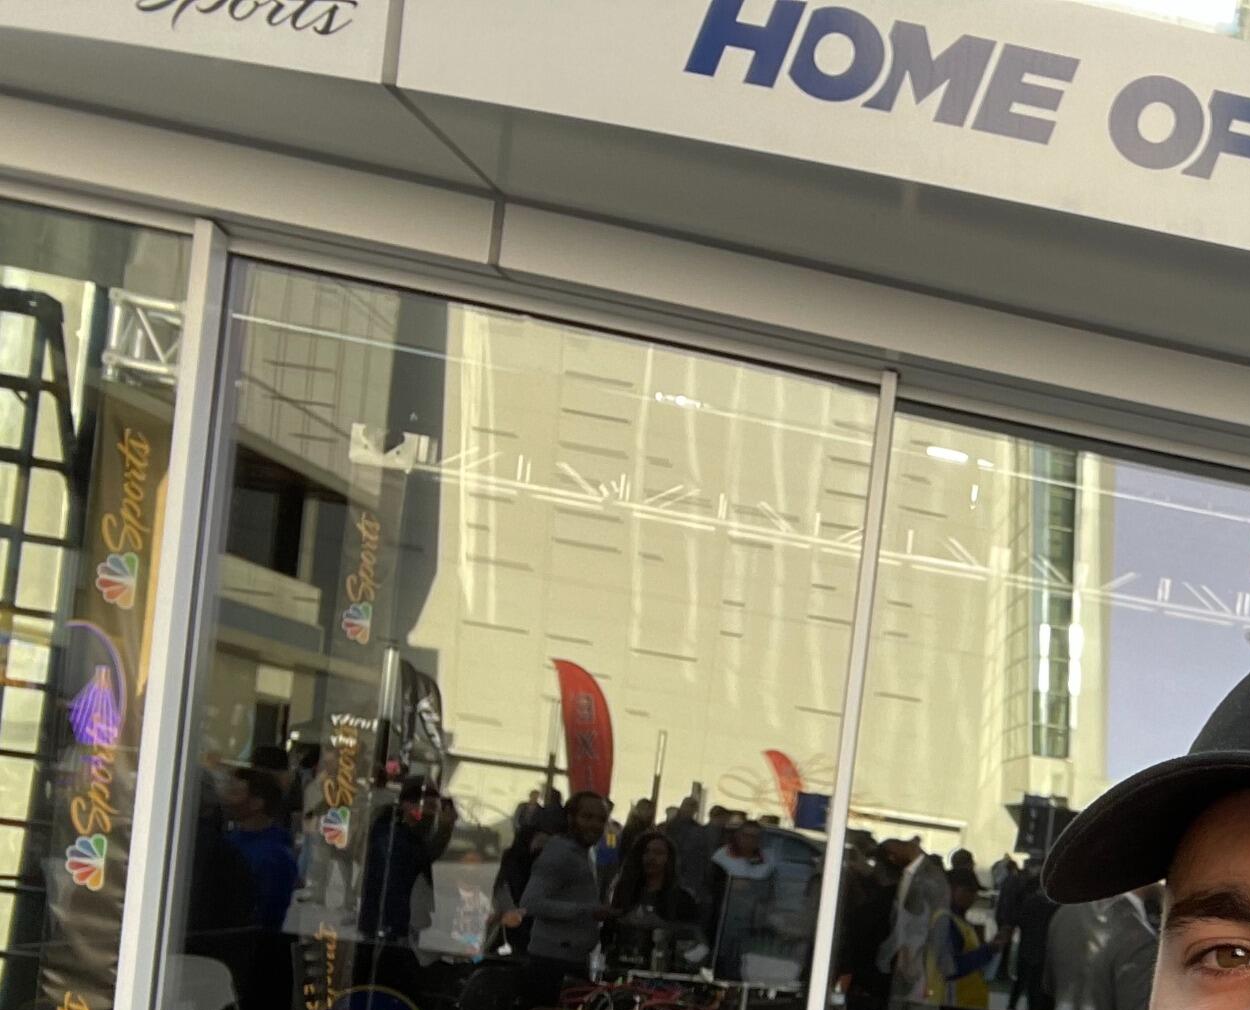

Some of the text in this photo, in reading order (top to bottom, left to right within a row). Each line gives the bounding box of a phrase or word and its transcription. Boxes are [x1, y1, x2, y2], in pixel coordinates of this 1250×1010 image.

[135, 0, 359, 36] ports
[684, 0, 1081, 146] HOME
[101, 427, 151, 551] Sports
[345, 511, 382, 604] Sports
